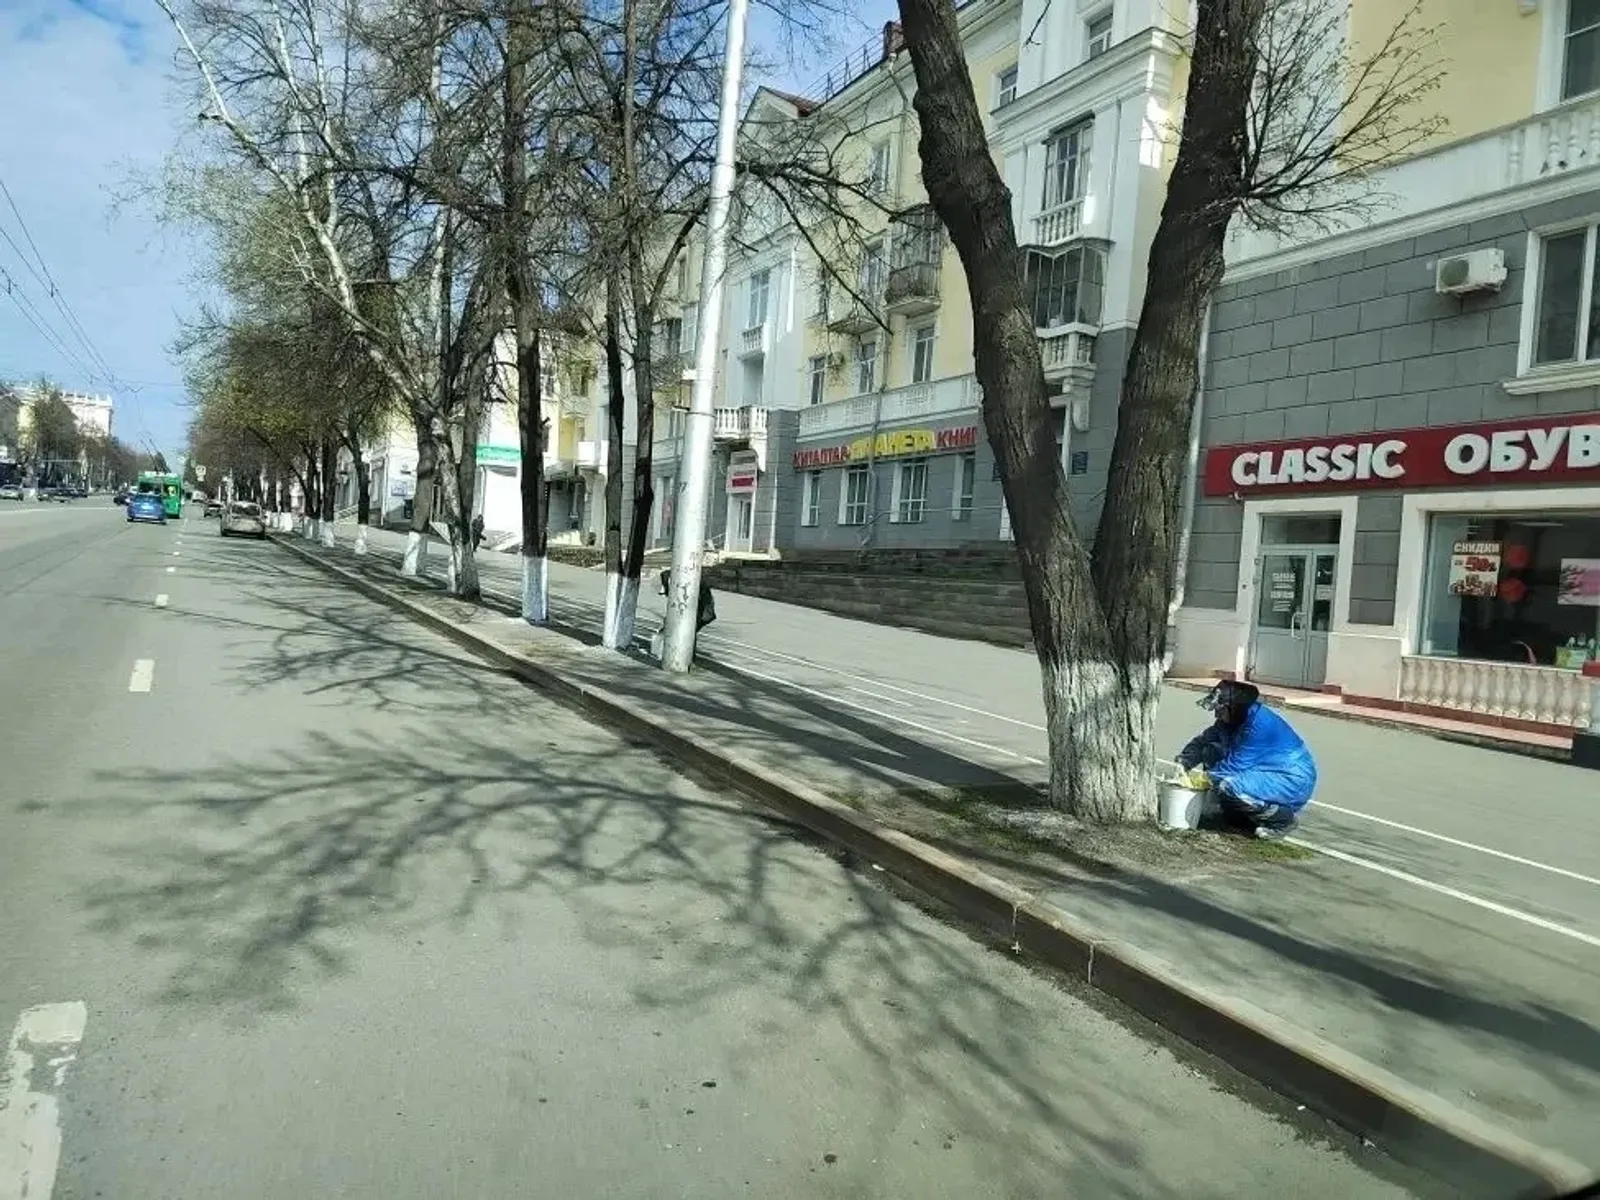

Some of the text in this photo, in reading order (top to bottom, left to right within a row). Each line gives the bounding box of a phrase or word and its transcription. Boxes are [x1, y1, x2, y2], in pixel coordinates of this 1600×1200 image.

[1231, 440, 1407, 486] CLASSIC
[1444, 424, 1600, 475] ОБУВ
[1454, 542, 1500, 553] СКИДКИ
